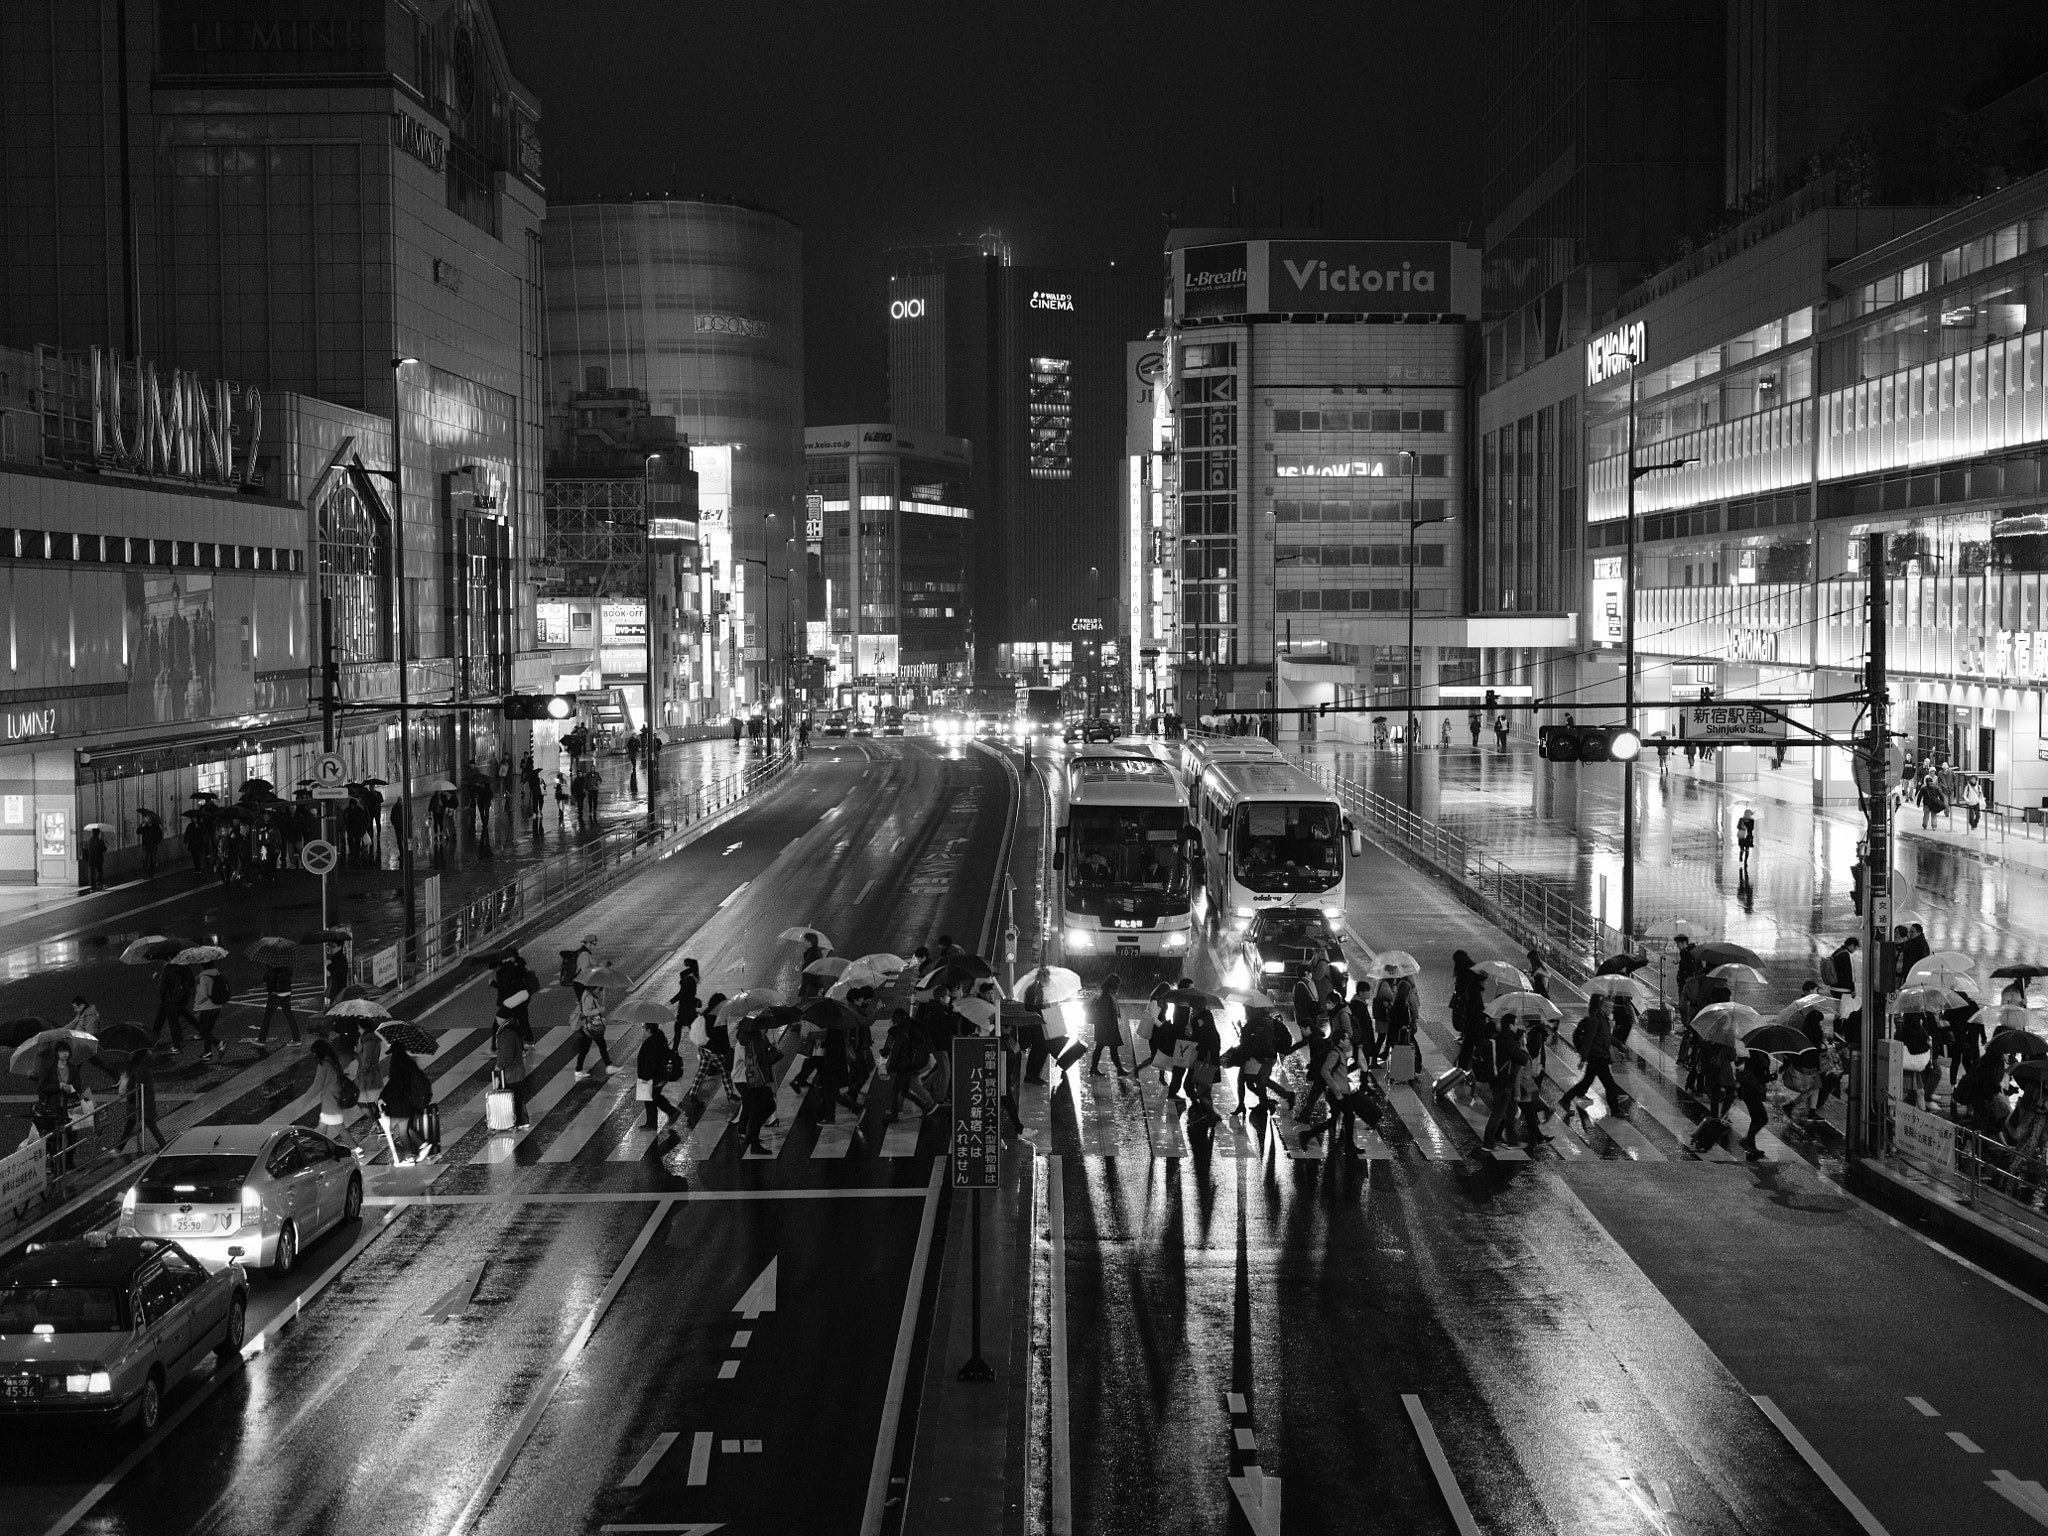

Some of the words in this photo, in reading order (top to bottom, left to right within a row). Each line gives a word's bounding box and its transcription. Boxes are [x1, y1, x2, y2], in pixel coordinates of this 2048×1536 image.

[1282, 259, 1435, 292] Victoria
[1029, 298, 1075, 312] CINEMA
[863, 431, 893, 443] KEIO
[1071, 623, 1104, 631] CINEMA
[1693, 707, 1779, 724] 新宿駅南口
[1706, 724, 1746, 735] Shinjuku
[1748, 724, 1767, 735] Sta.
[970, 1067, 983, 1158] バスタ新宿へは
[956, 1119, 969, 1184] 入れません
[5, 1386, 35, 1398] 45-36
